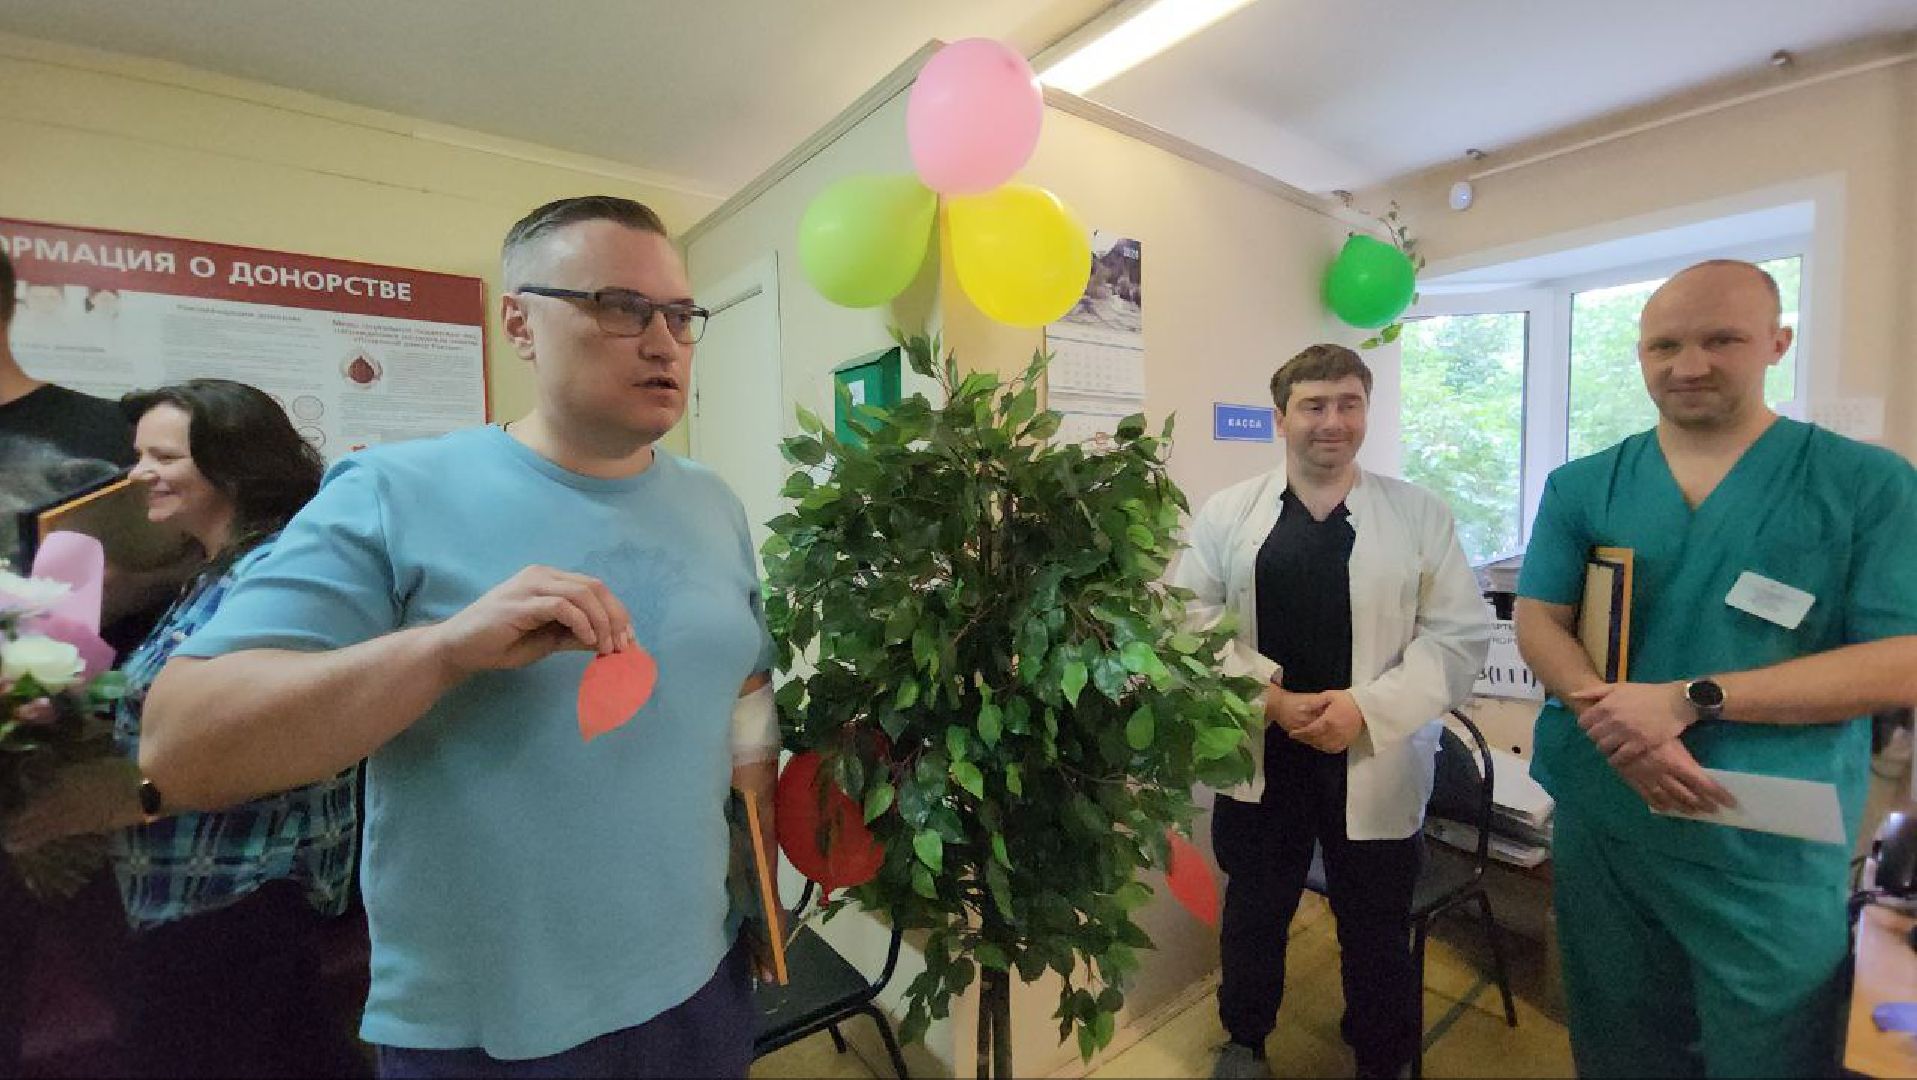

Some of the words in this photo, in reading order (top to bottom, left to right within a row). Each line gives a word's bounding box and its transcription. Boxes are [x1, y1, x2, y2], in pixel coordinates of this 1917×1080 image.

[189, 256, 216, 278] О
[228, 261, 412, 302] ДОНОРСТВЕ
[1228, 418, 1262, 429] КАССА
